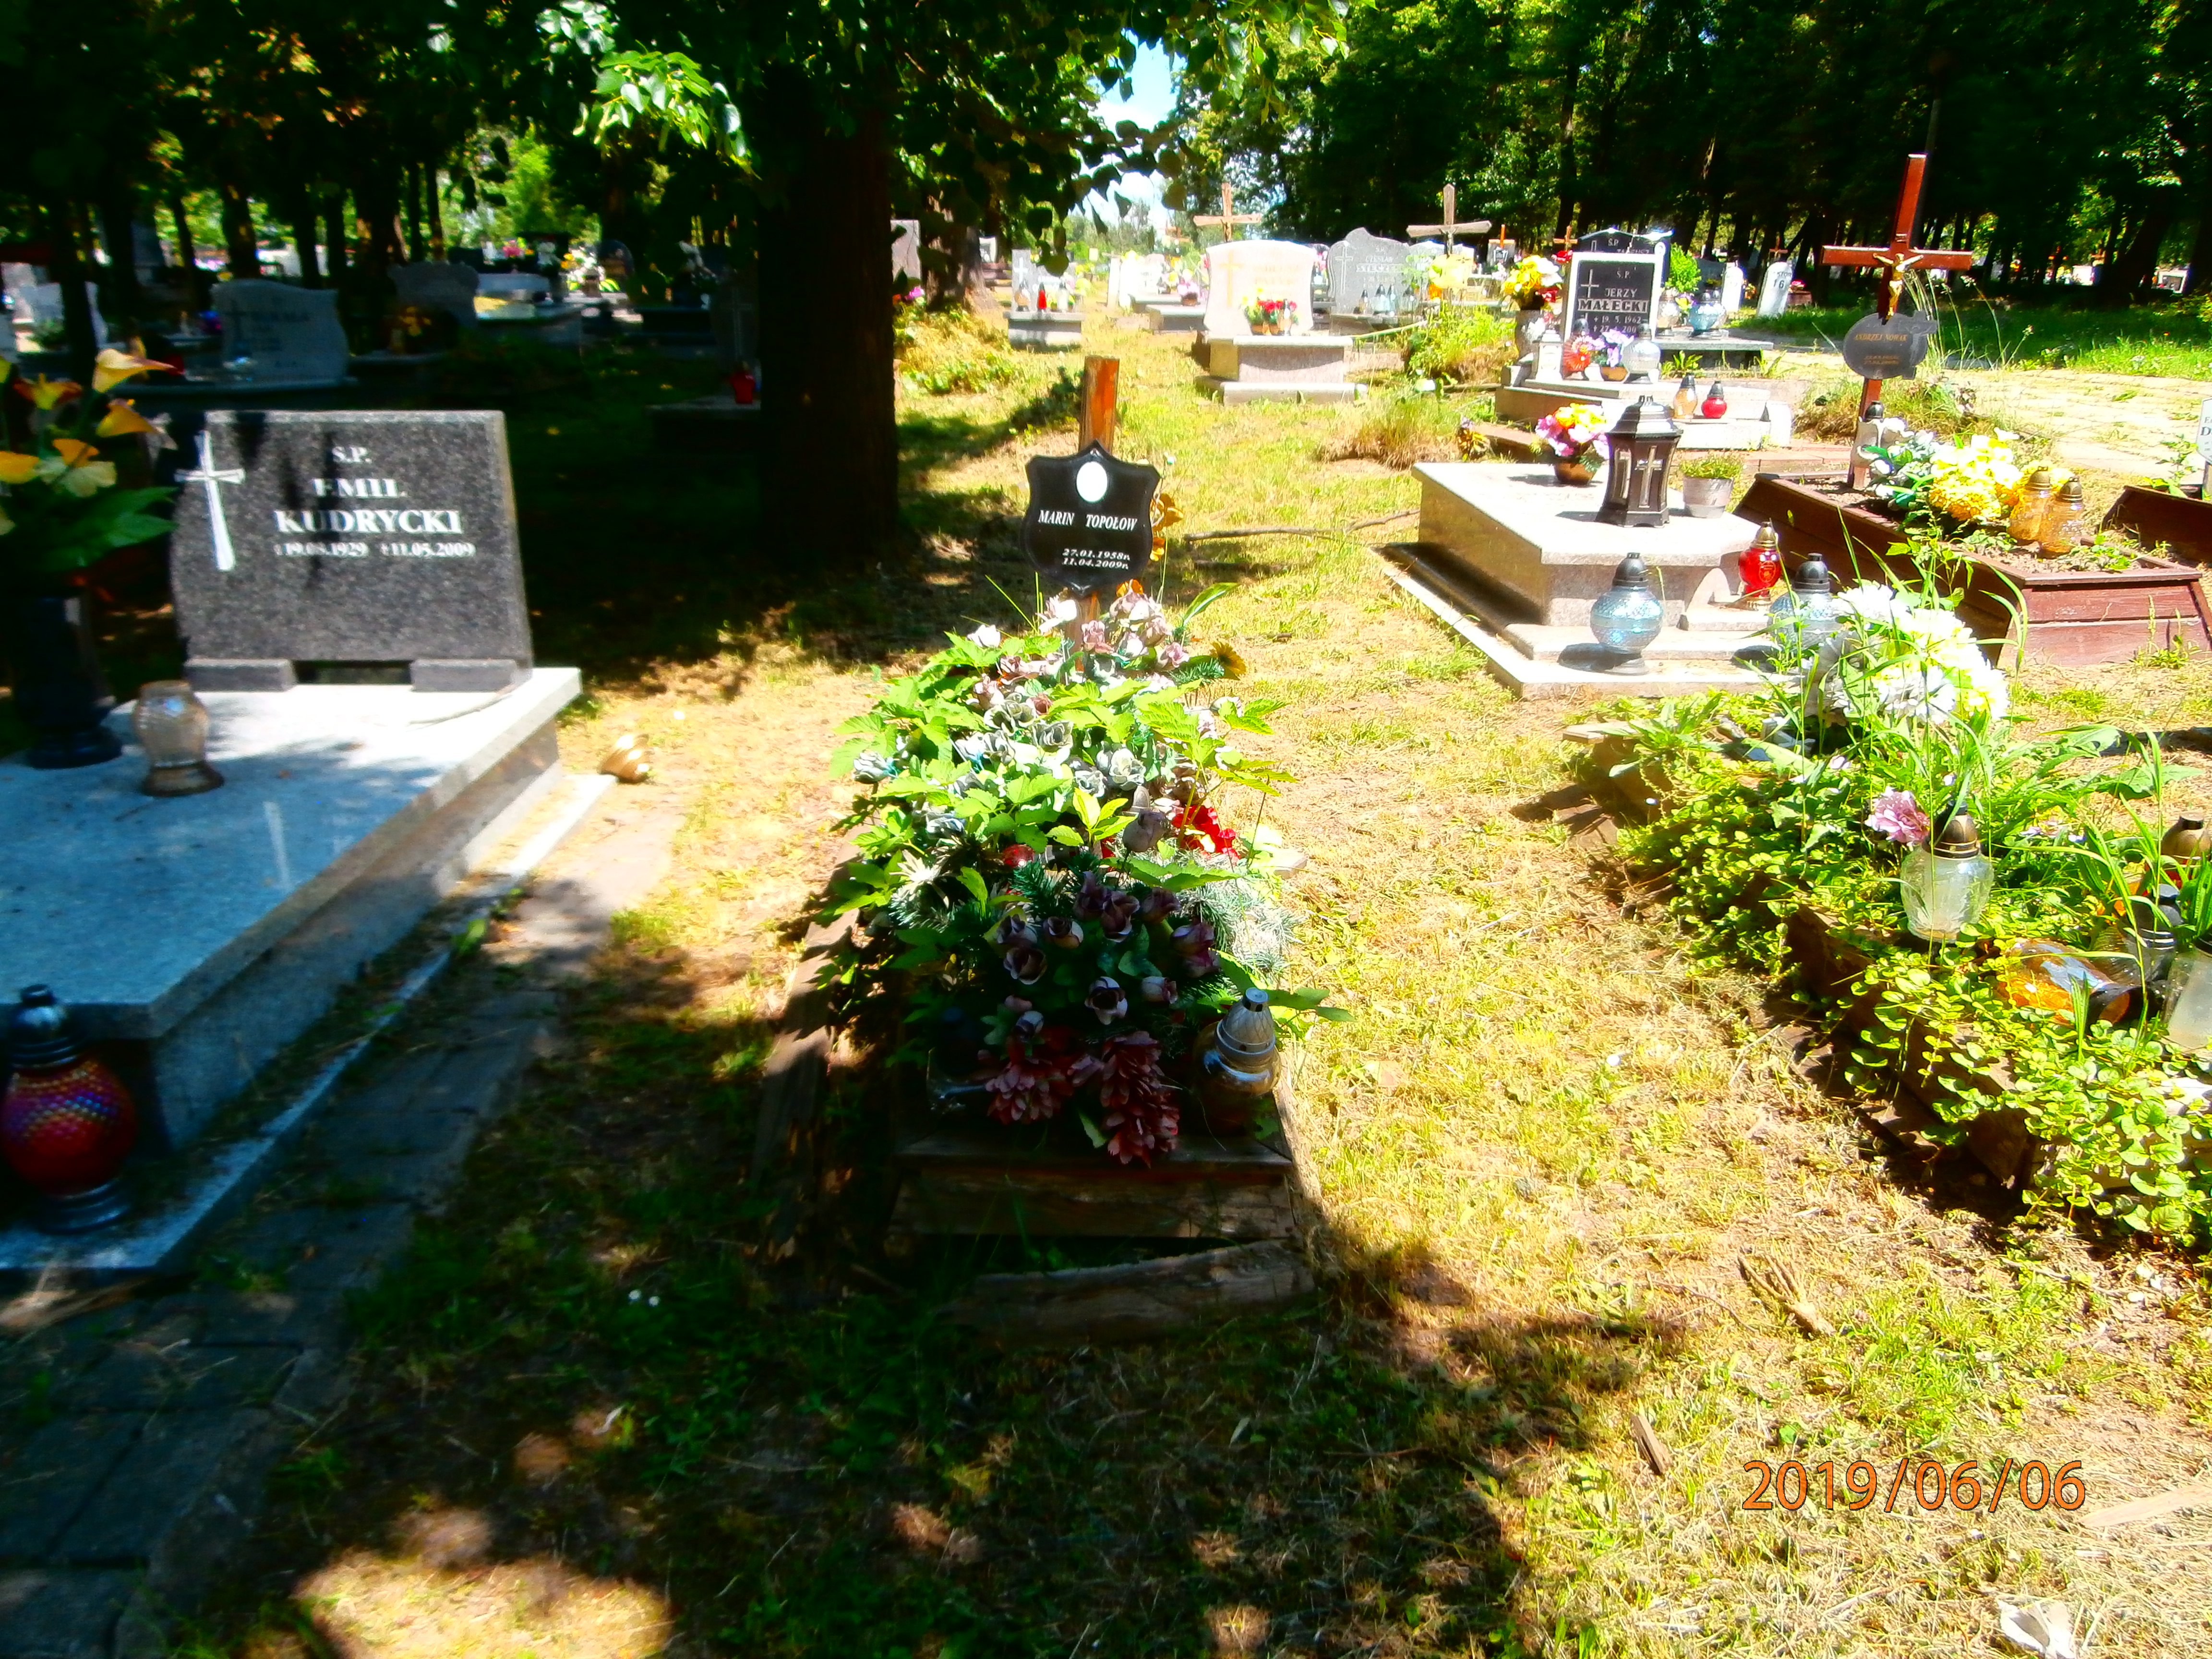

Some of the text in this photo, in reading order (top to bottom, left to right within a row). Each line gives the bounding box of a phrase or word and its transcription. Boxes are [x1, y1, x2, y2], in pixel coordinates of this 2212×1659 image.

[1773, 278, 1785, 289] 16
[1605, 288, 1637, 298] JERZY
[1578, 298, 1648, 313] MAŁECKI
[312, 478, 409, 499] EMIL
[273, 509, 464, 534] KUDRYCKI
[1037, 509, 1075, 526] MARIN
[1061, 557, 1129, 570] 11.04.2009r.
